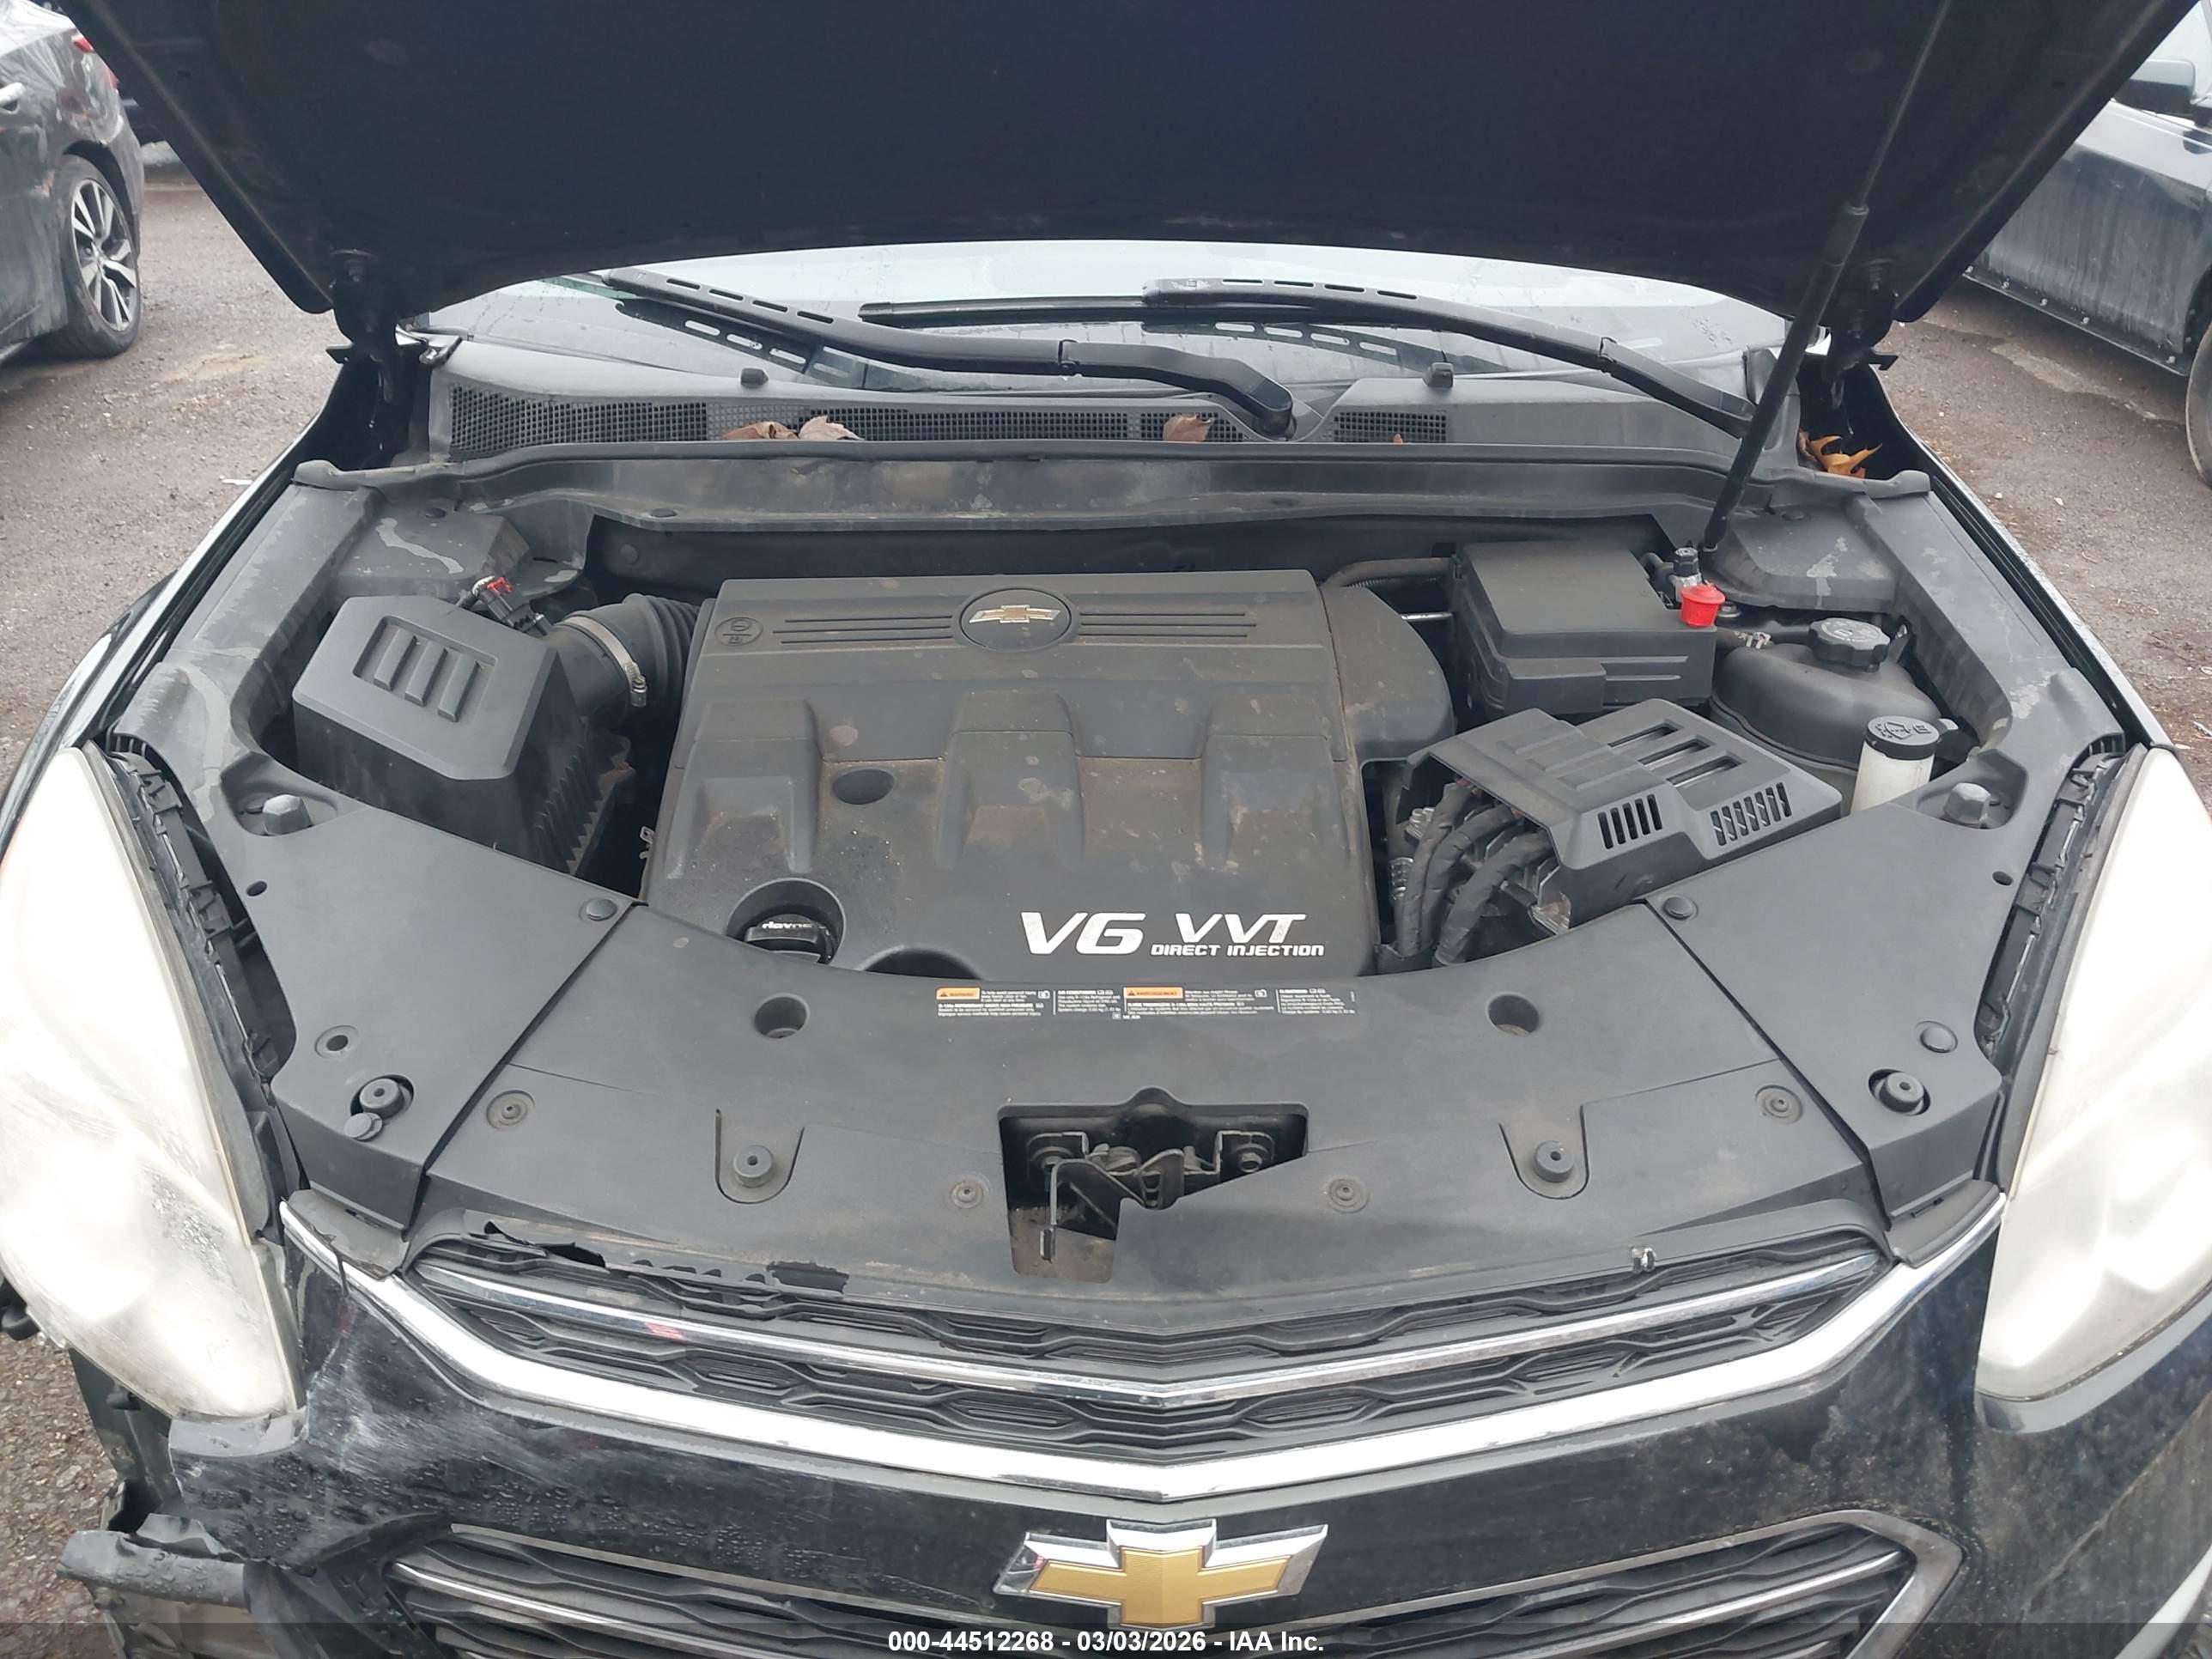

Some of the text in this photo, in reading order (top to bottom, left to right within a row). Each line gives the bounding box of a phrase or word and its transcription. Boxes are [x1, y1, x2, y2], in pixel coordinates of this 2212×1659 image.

[1021, 912, 1307, 956] V6 VVT
[1151, 944, 1325, 957] DIRECT INJECTION
